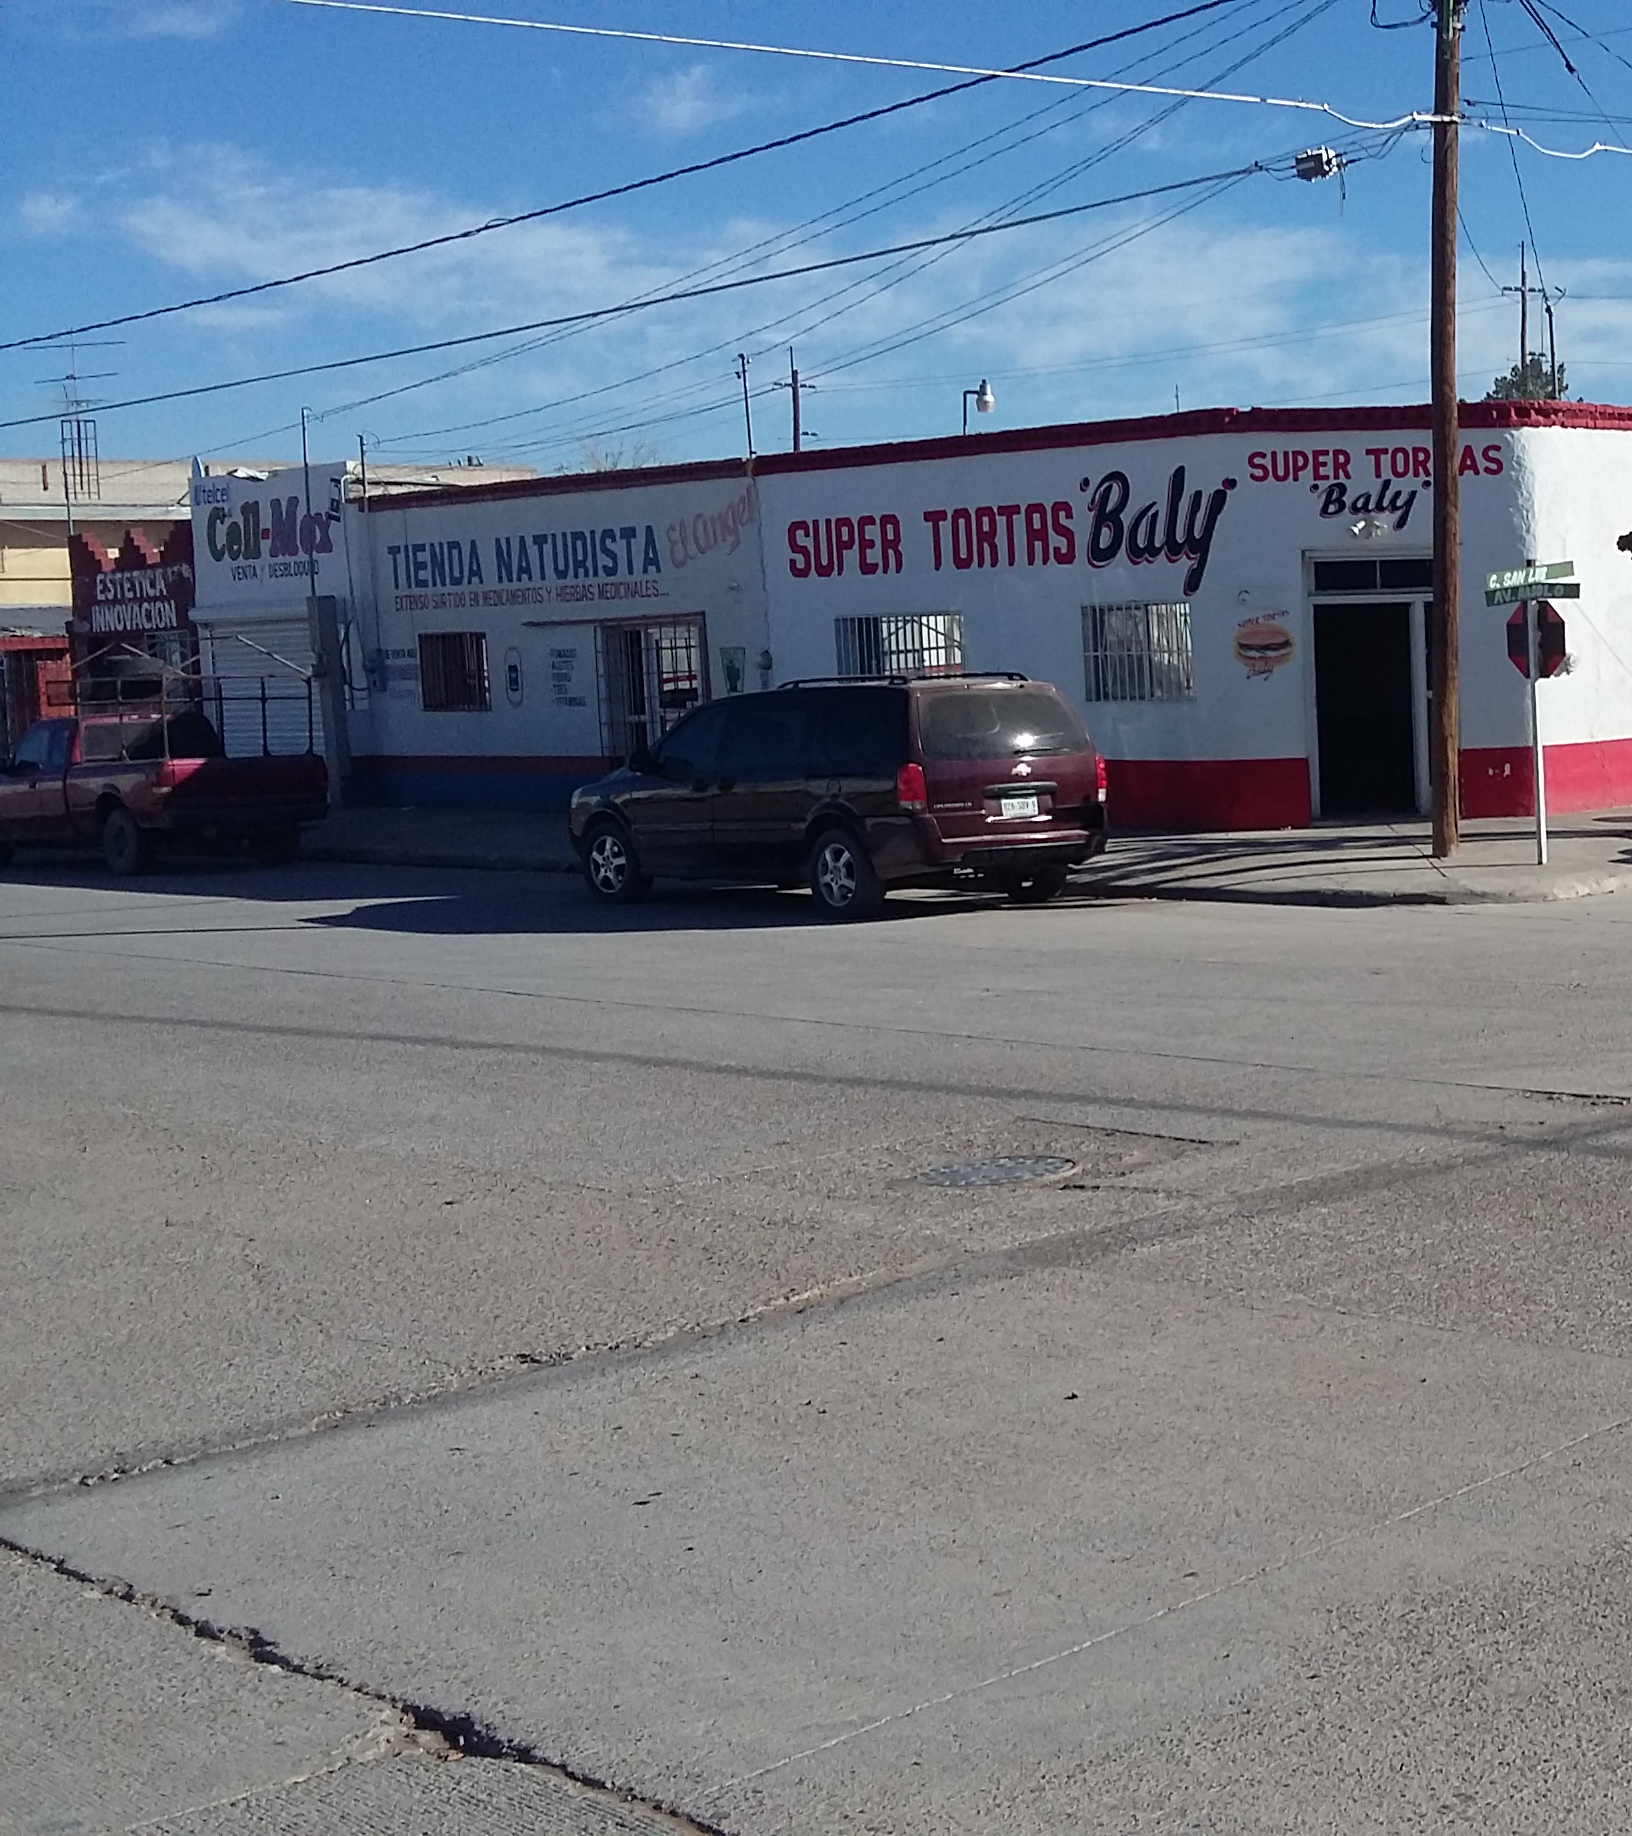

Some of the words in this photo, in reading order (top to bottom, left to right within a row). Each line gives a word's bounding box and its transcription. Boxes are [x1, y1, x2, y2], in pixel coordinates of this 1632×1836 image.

[1247, 449, 1352, 483] SUPER
[1365, 444, 1504, 479] TORAS
[787, 513, 903, 578] SUPER
[923, 500, 1077, 571] TORTAS
[231, 564, 258, 581] VENTA
[269, 559, 319, 579] DESBLOQUO
[387, 539, 484, 590] TIENDA
[494, 525, 662, 584] NATURISTA
[96, 568, 167, 600] ESTETICA
[1503, 569, 1526, 587] SAN
[482, 587, 544, 607] MEDICAMENTOS
[545, 586, 552, 604] Y
[556, 584, 595, 604] HIERBAS
[91, 600, 177, 632] INNOVACION
